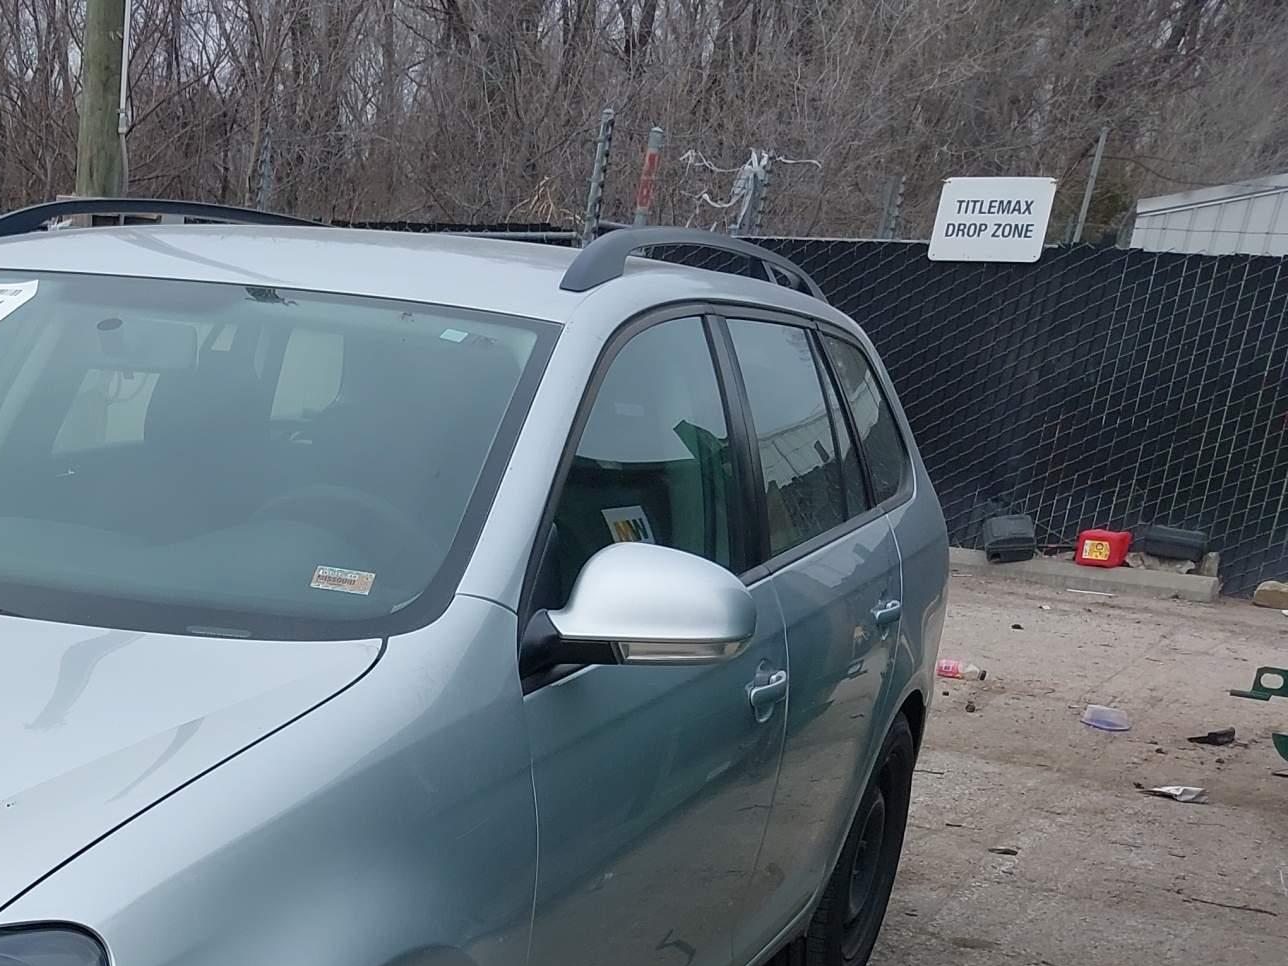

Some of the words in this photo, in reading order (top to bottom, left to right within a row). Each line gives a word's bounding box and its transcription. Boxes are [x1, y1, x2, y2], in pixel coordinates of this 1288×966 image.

[956, 199, 1034, 215] TITLEMAX
[944, 222, 988, 238] DROP
[991, 223, 1035, 238] ZONE
